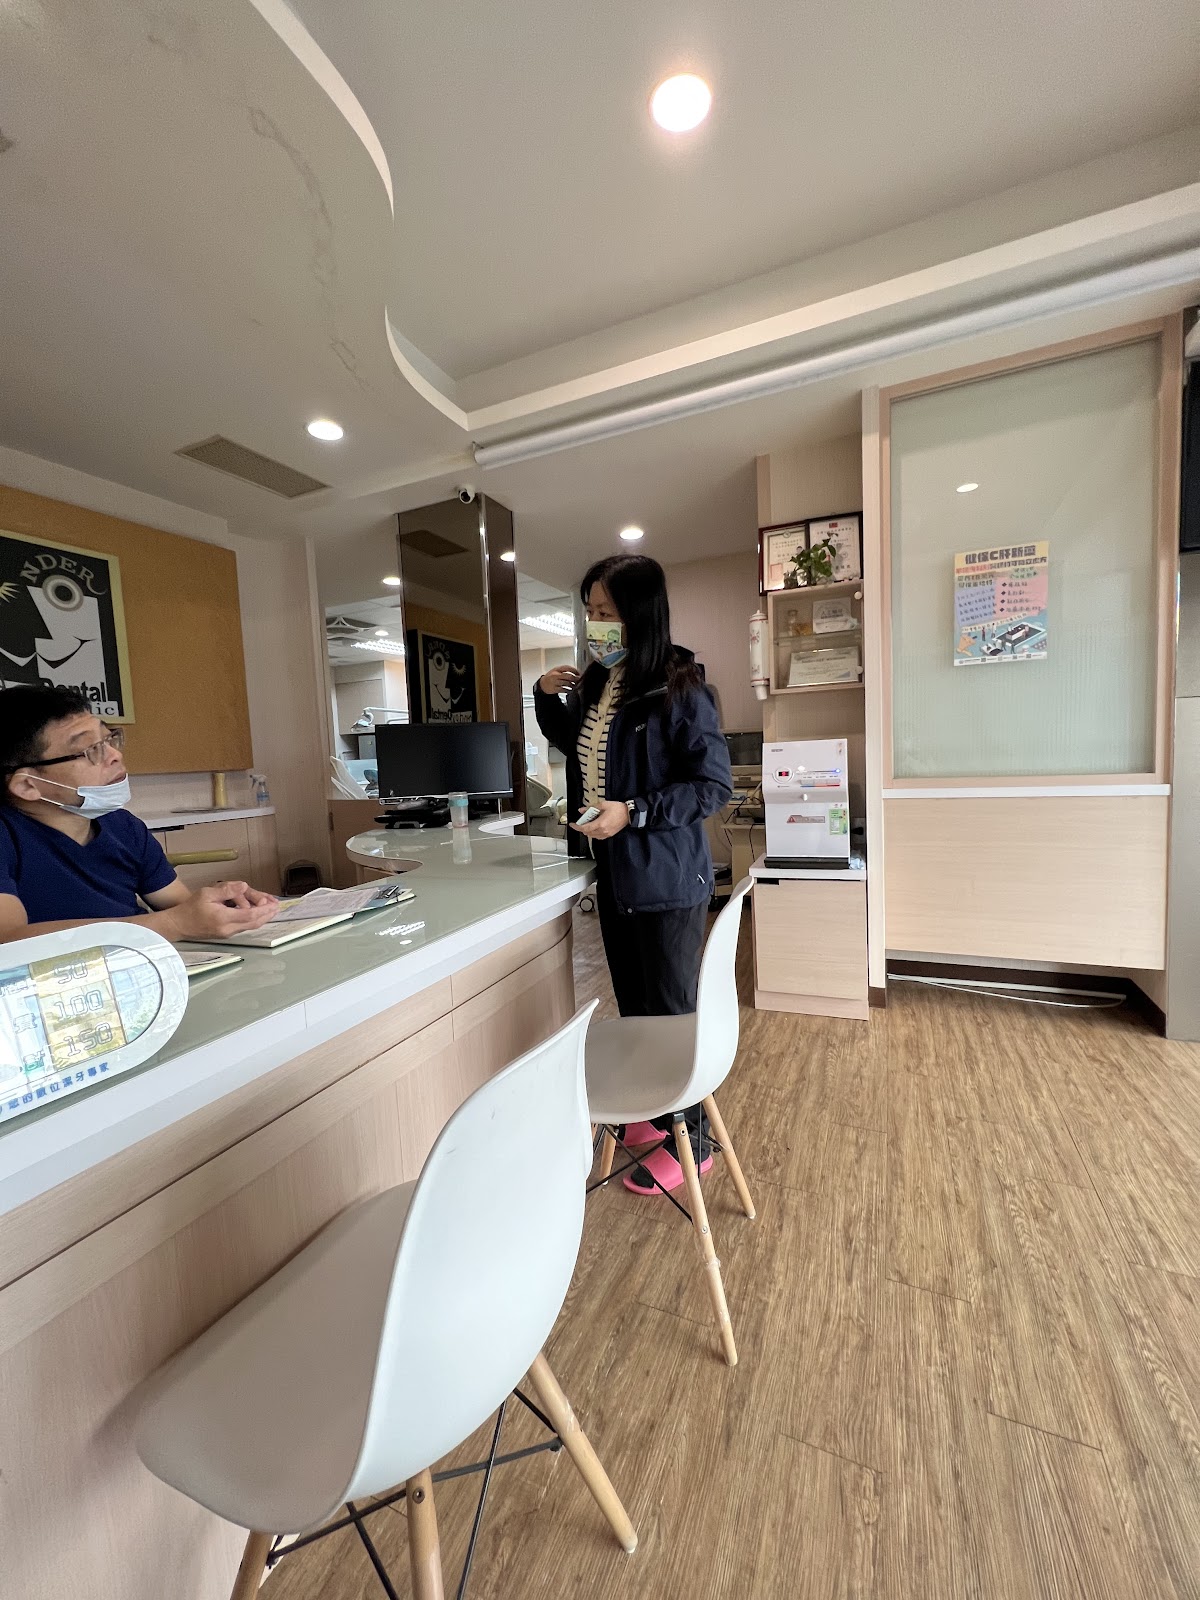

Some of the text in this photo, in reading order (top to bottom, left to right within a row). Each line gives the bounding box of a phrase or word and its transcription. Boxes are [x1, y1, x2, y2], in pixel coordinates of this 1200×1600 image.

[54, 989, 104, 1021] 100
[63, 1022, 113, 1057] 150
[0, 1062, 110, 1114] 您的數位潔牙專家
